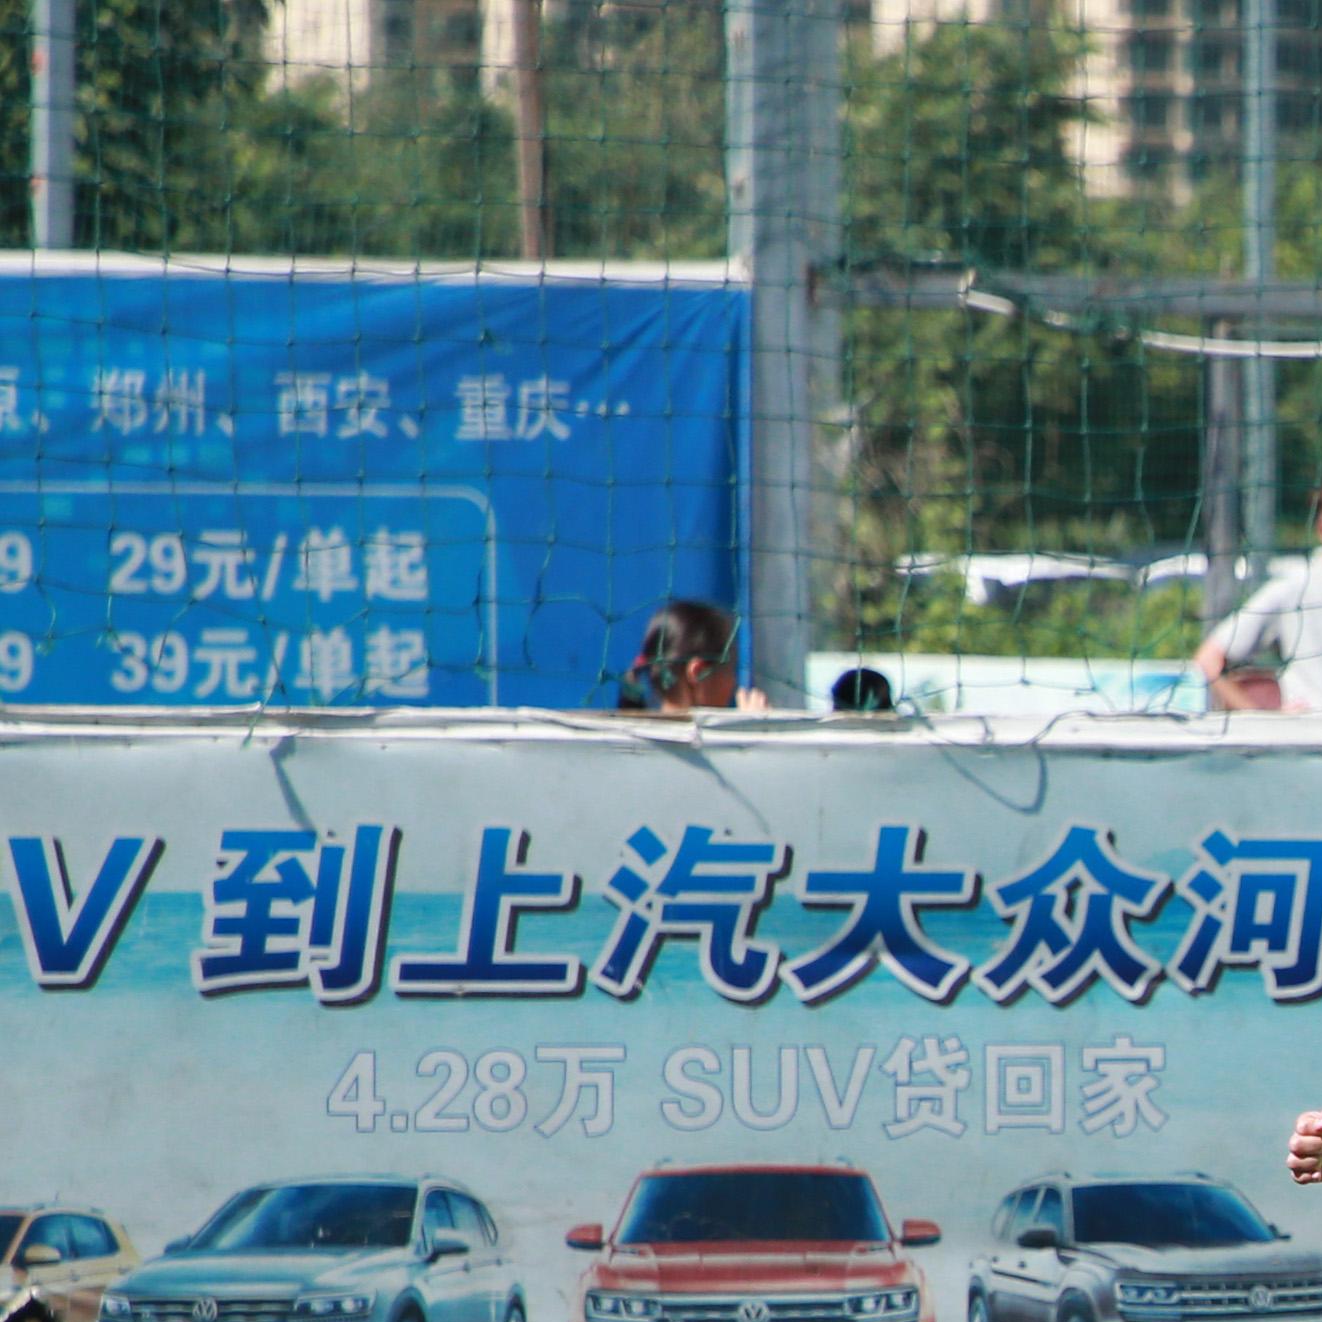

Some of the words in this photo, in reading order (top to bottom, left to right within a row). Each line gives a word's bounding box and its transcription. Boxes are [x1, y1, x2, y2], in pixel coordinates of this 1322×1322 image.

[109, 526, 430, 602] 29元/单起
[110, 626, 430, 704] 39元/单起
[326, 1044, 627, 1139] 4.28万
[660, 1035, 1171, 1140] SUV贷回家
